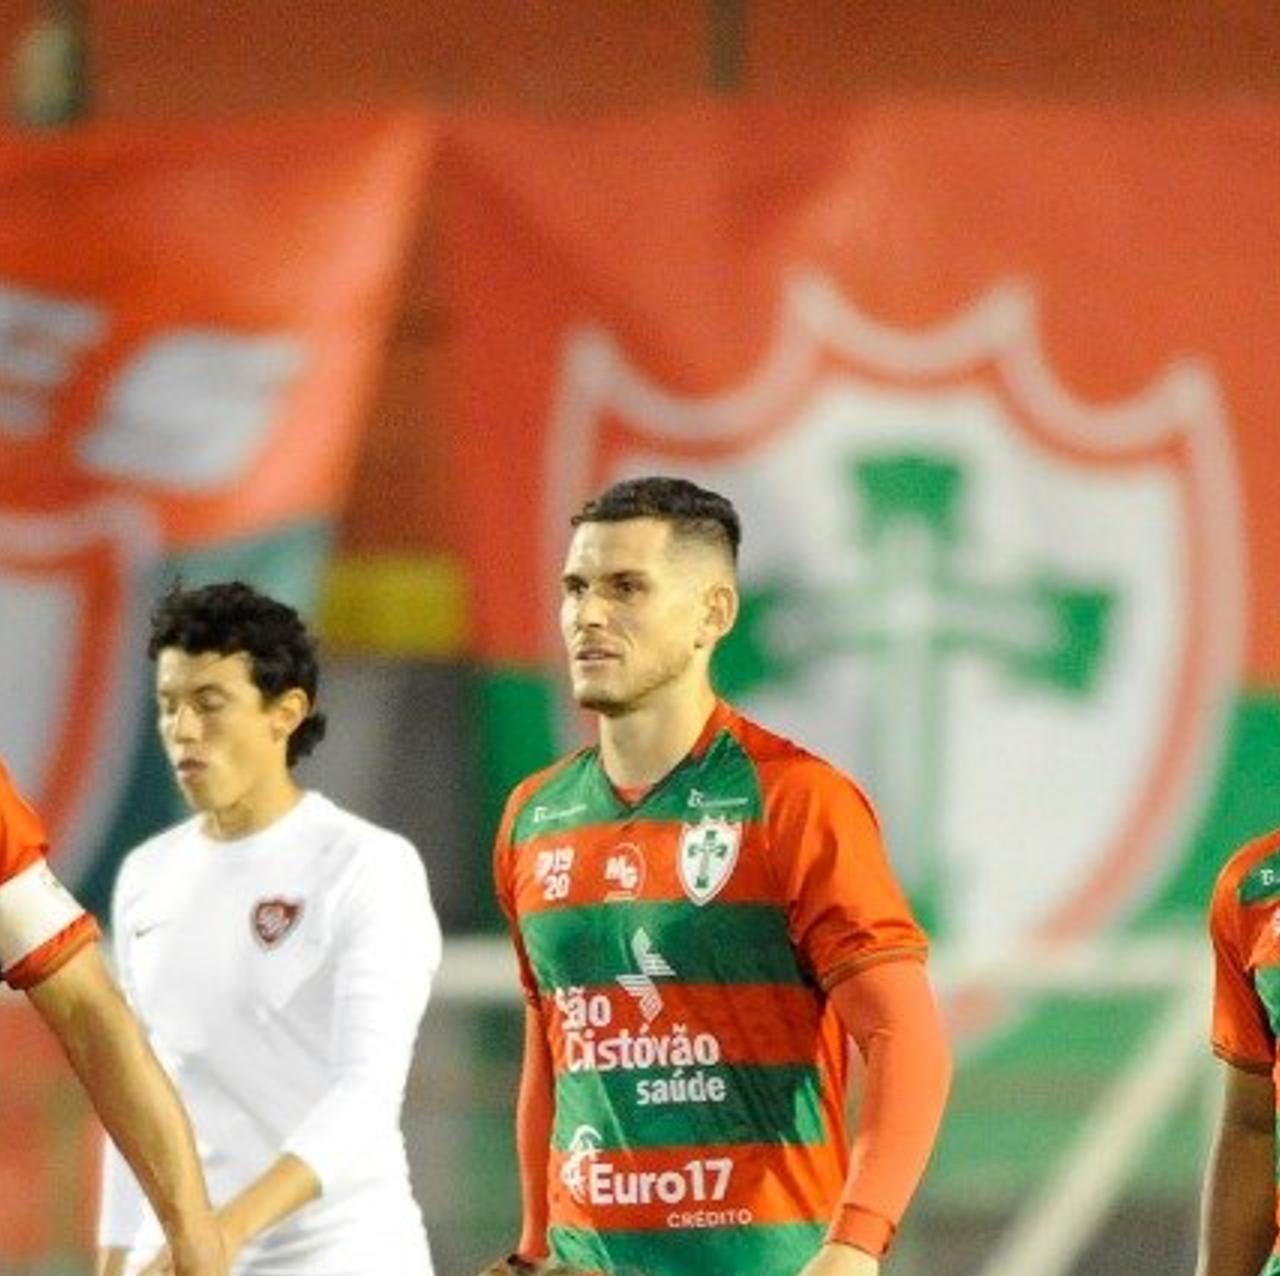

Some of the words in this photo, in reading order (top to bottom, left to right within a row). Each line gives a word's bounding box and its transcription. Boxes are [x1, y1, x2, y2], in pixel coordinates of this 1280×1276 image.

[565, 1022, 721, 1072] Cistóvão
[636, 1067, 727, 1106] saúde
[590, 1158, 734, 1205] Euro17
[667, 1208, 752, 1229] CRÉDITO
